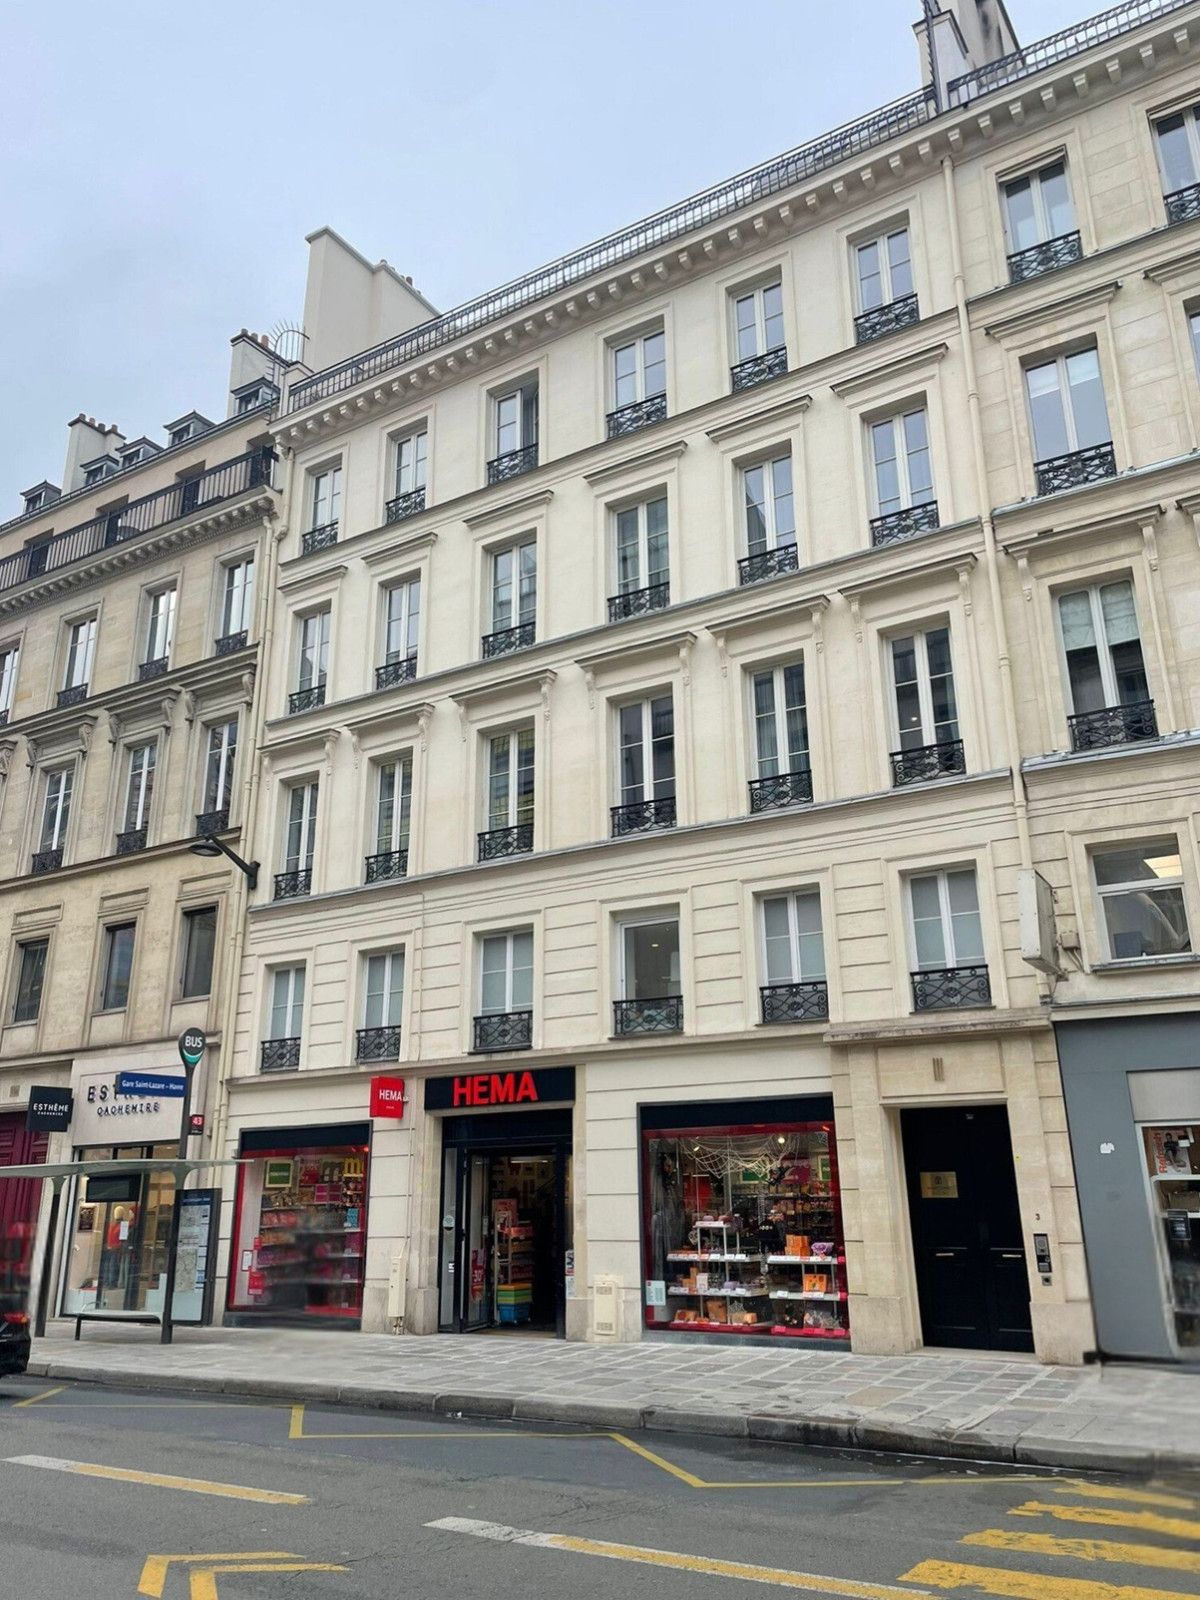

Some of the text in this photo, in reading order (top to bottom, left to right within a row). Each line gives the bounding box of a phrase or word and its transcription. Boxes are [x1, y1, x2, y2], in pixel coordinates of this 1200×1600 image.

[185, 1035, 202, 1047] BUS
[453, 1071, 538, 1106] HEMA
[379, 1089, 402, 1101] HEMA
[33, 1102, 69, 1112] ESTHÊME
[192, 1116, 203, 1125] 43
